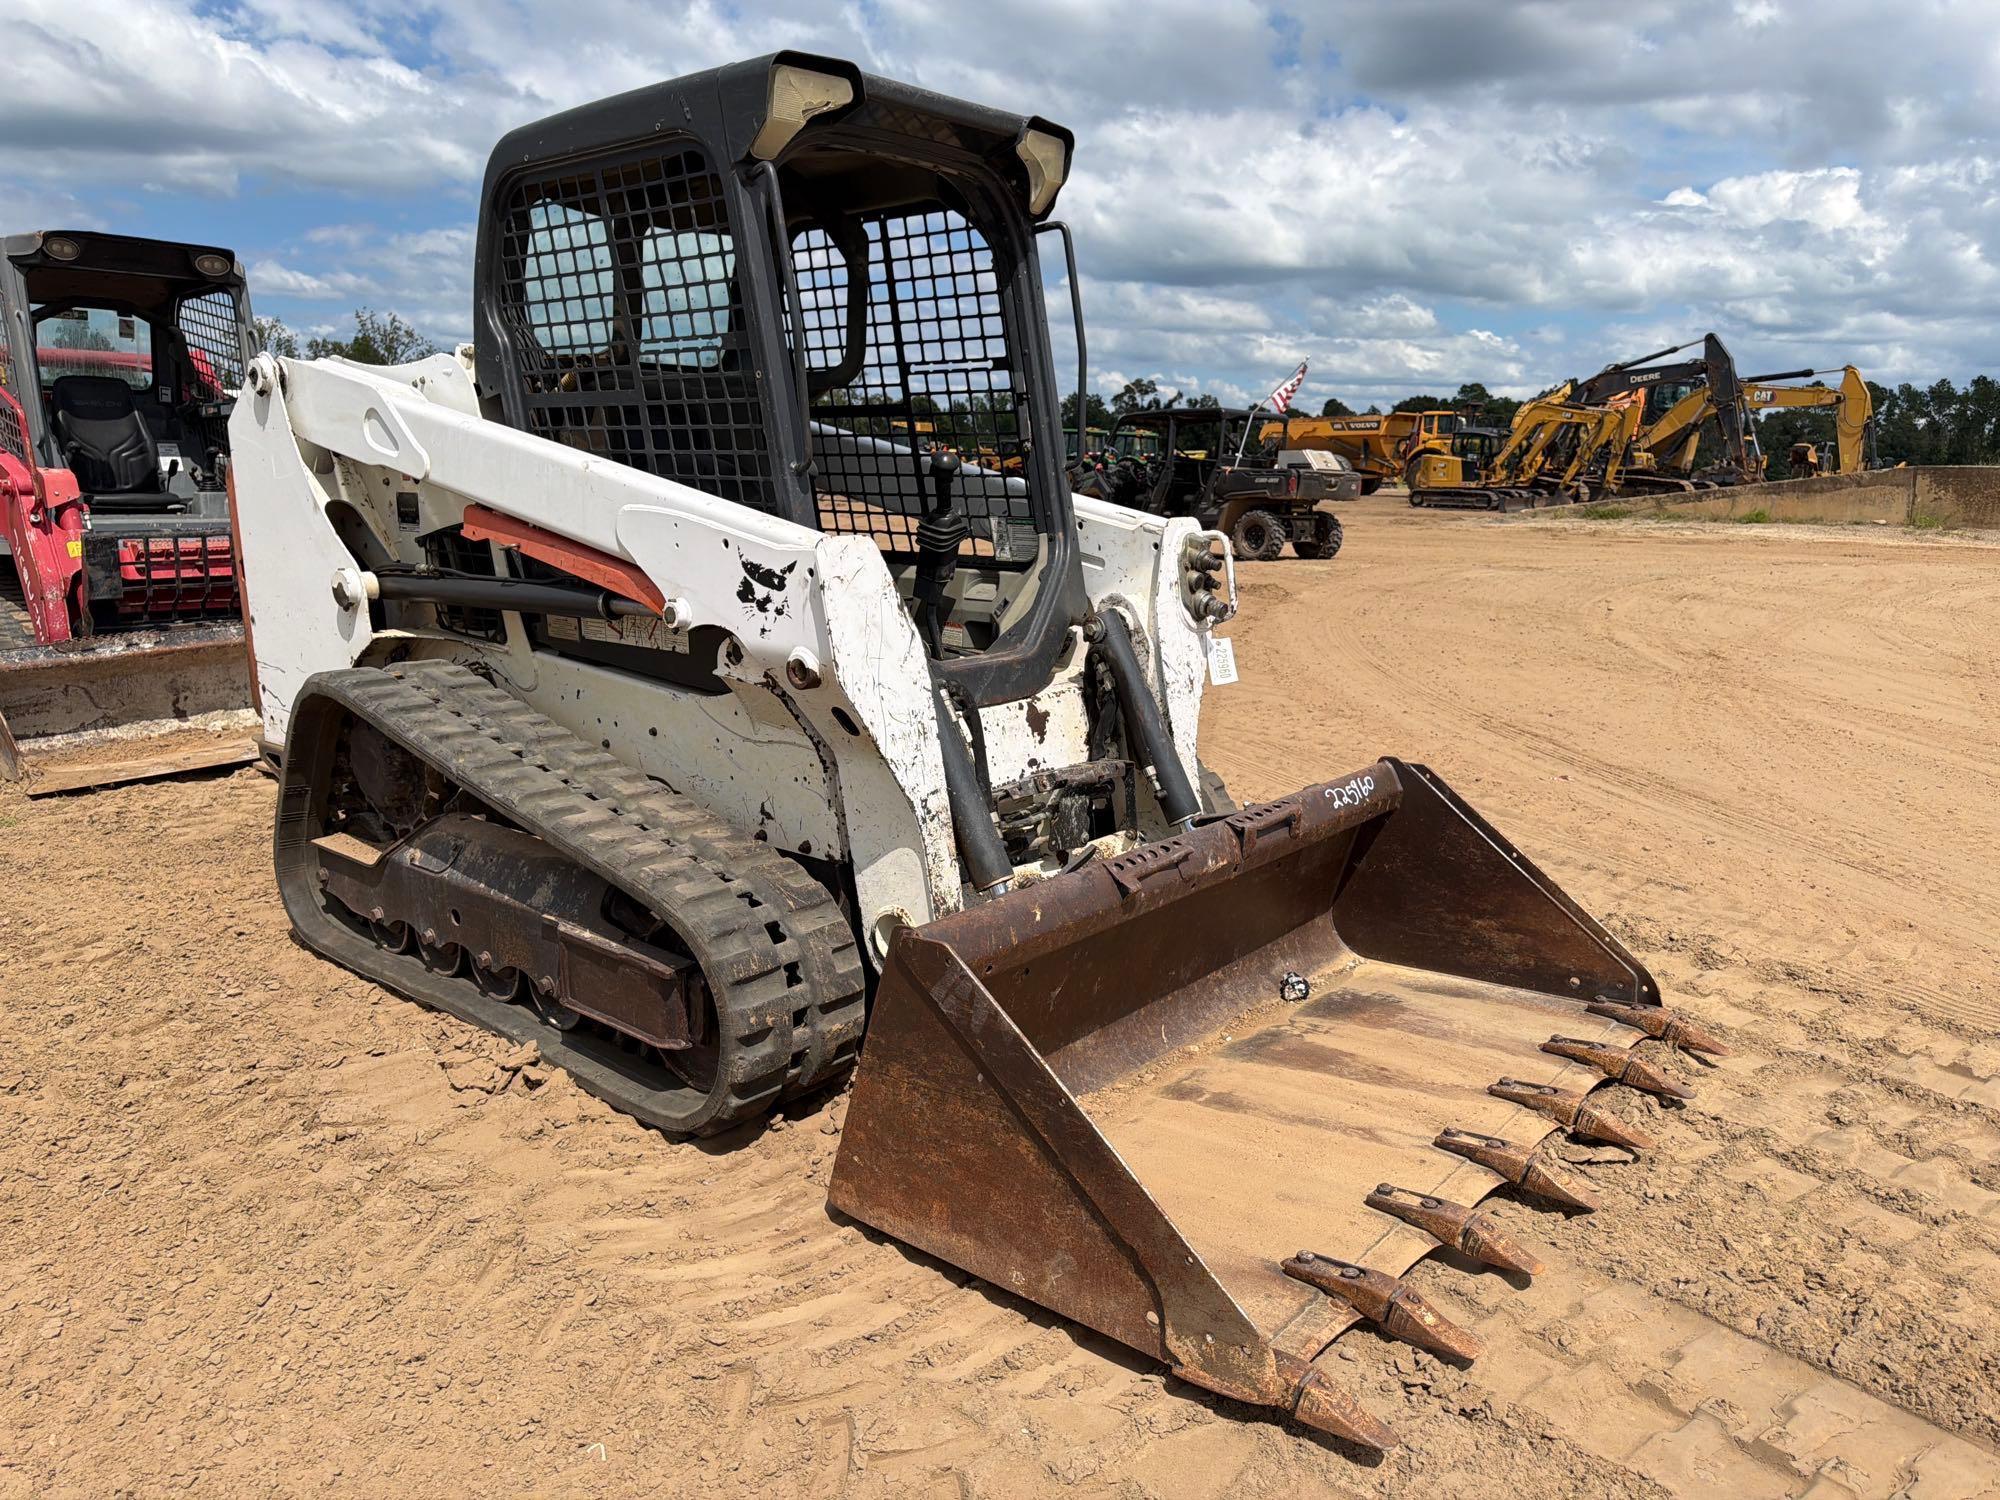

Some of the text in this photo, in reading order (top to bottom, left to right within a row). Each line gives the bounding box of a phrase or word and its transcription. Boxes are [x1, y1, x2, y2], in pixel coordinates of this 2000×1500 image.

[1630, 372, 1661, 383] DEERE
[1754, 391, 1772, 401] CAT
[1216, 648, 1232, 679] 225960
[1325, 776, 1375, 809] 225960
